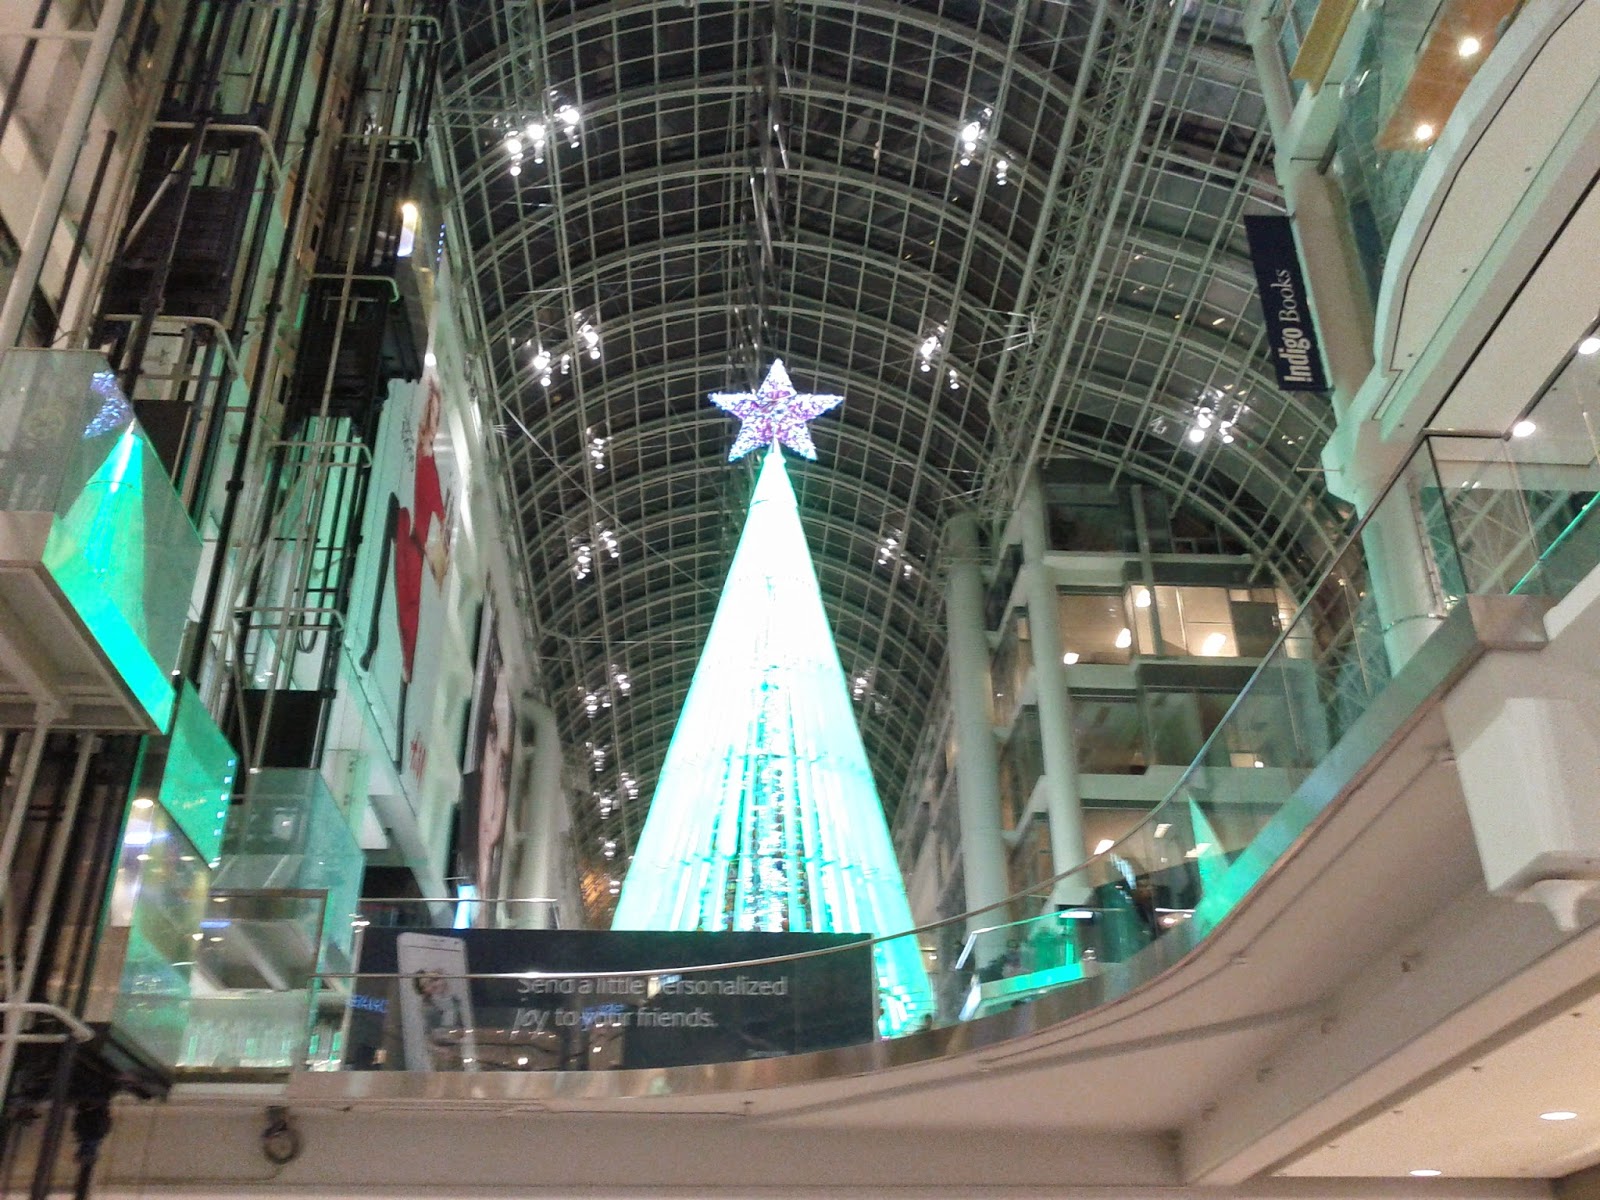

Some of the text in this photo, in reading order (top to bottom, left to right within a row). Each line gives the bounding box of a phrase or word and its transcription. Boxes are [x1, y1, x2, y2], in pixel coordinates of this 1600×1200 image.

[1270, 269, 1313, 382] Indigo Books
[517, 977, 576, 994] Send
[578, 979, 594, 994] a
[596, 976, 646, 994] little
[554, 1007, 580, 1026] to
[637, 1006, 719, 1028] friends.
